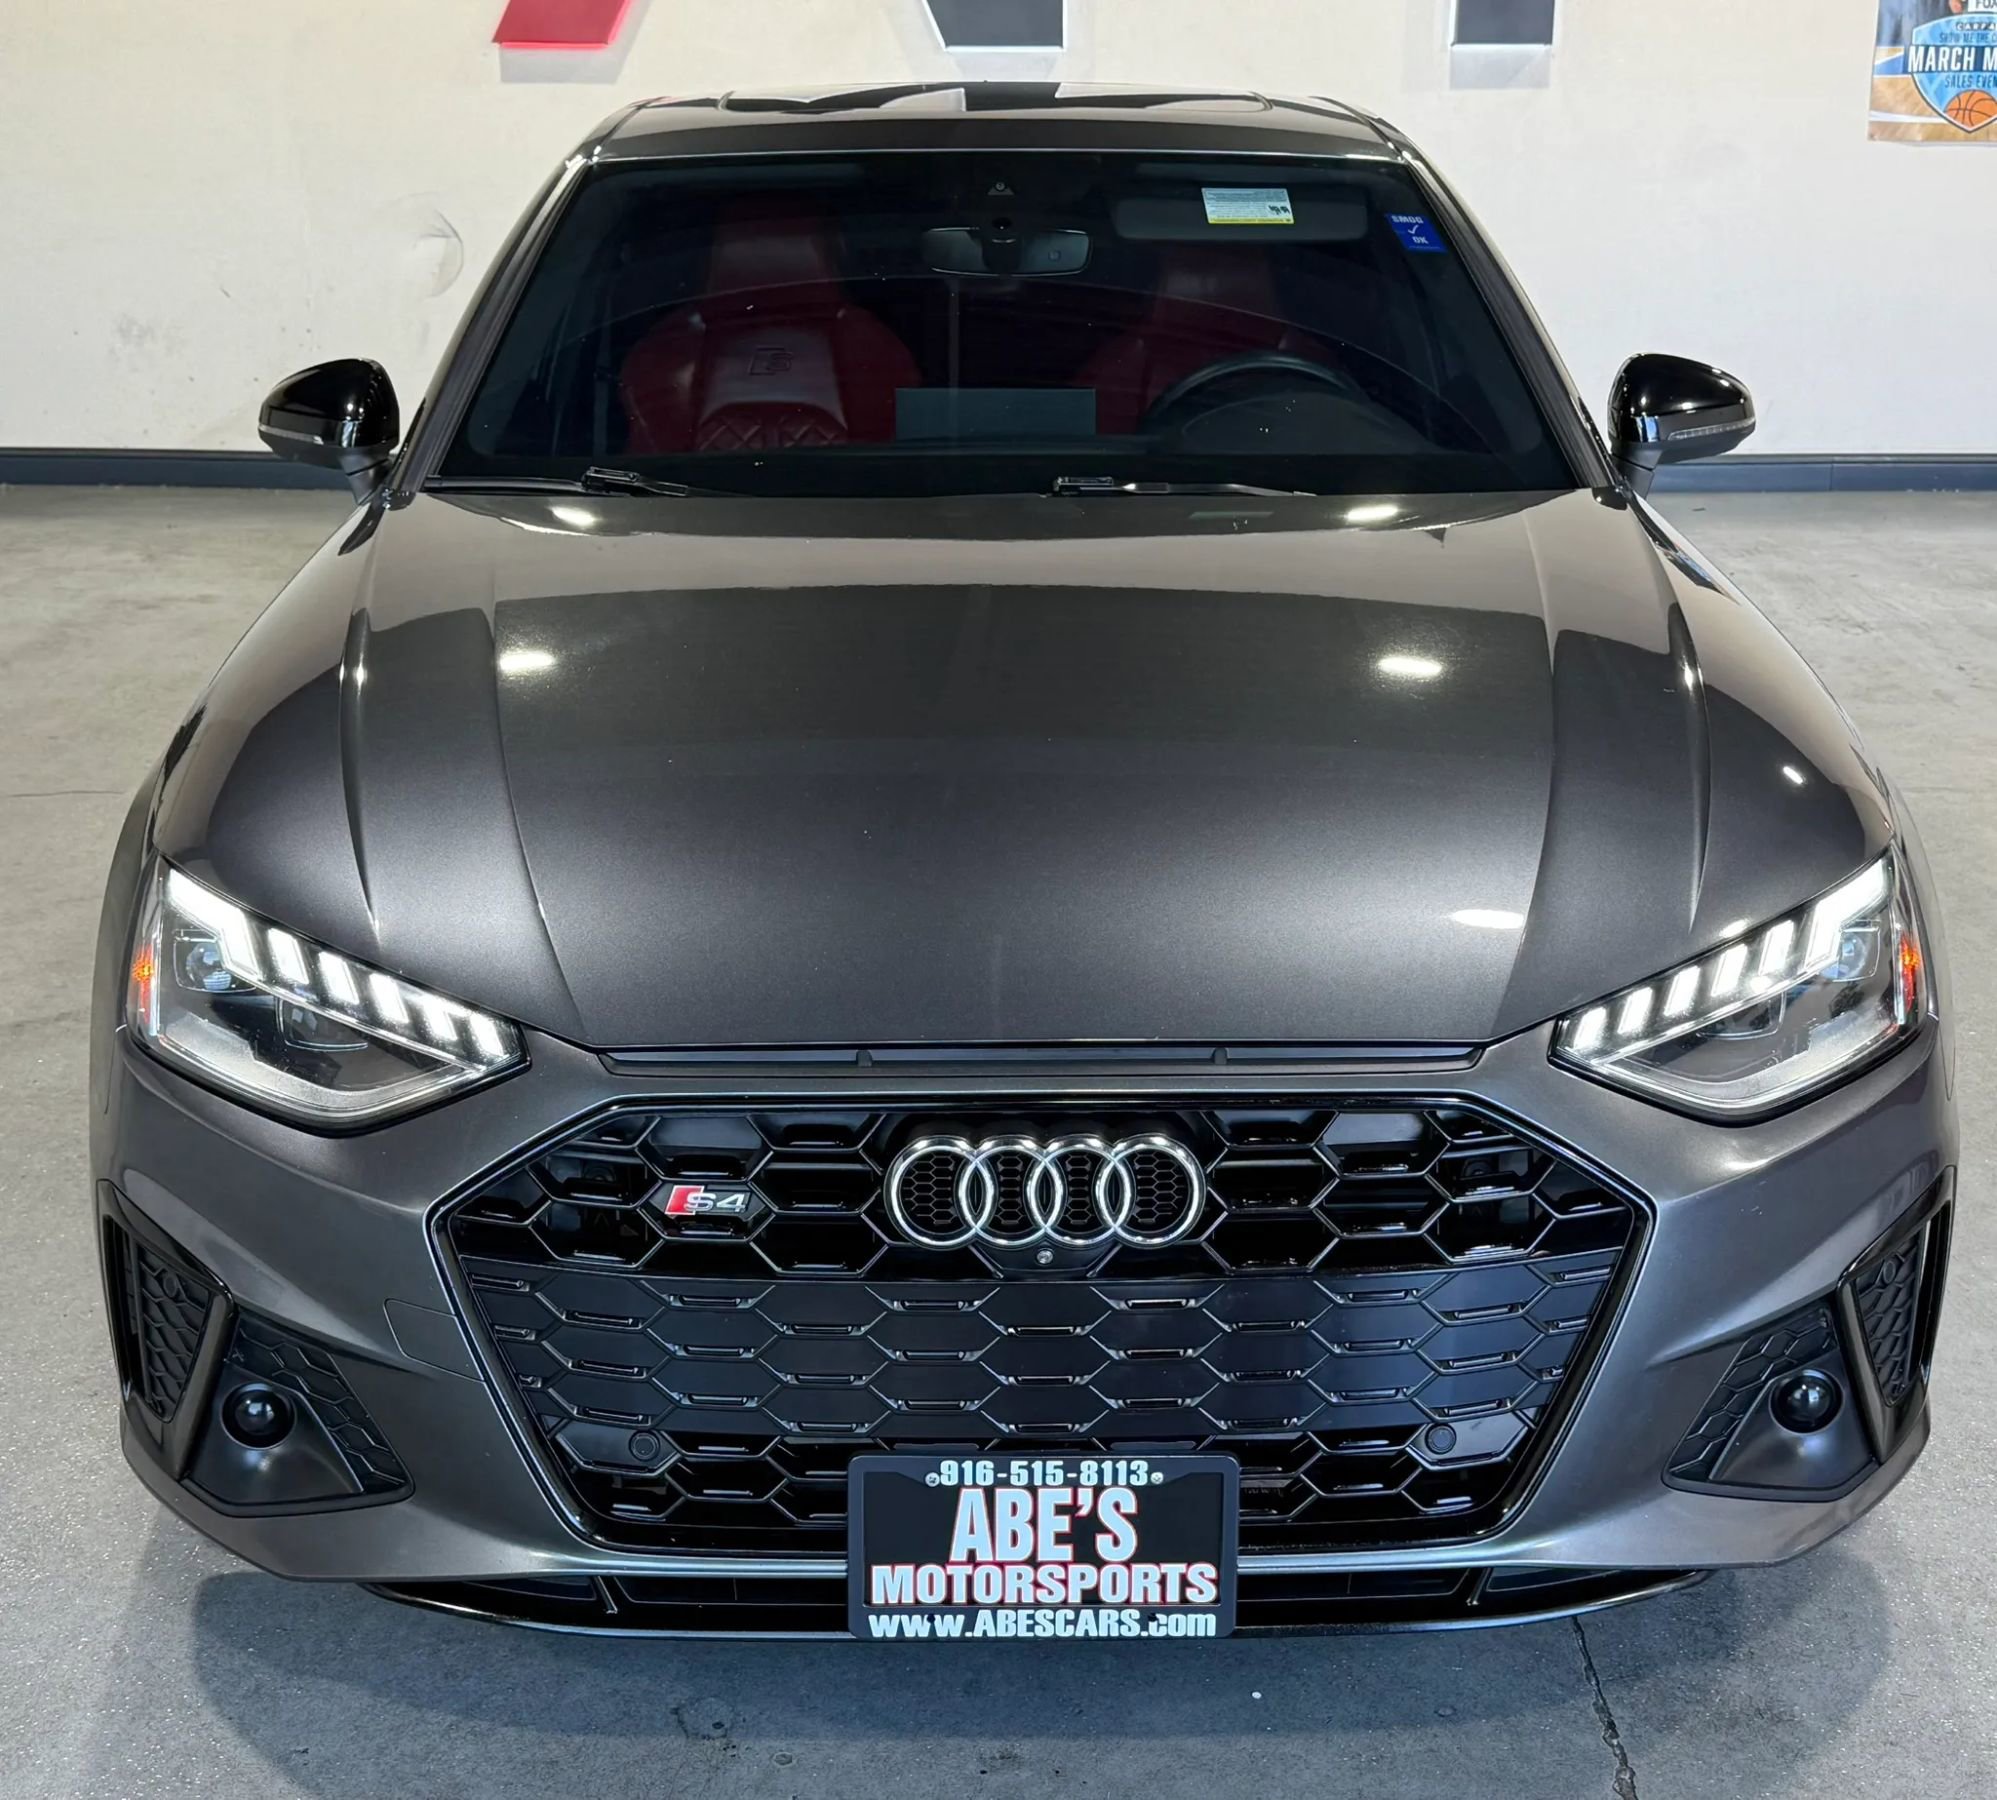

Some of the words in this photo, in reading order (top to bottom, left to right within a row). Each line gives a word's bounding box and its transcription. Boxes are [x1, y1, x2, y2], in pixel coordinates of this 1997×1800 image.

[1957, 23, 1997, 31] CARFA
[1908, 45, 1976, 72] MARCH
[1944, 75, 1972, 88] SALES
[1391, 215, 1424, 224] SMOG
[1412, 236, 1429, 245] OK
[682, 1191, 746, 1213] S4
[939, 1459, 1149, 1487] 916-515-8113
[949, 1487, 1139, 1563] ABE’S
[870, 1562, 1218, 1605] MOTORSPORTS
[868, 1609, 1216, 1638] www.ABESCARS.com
